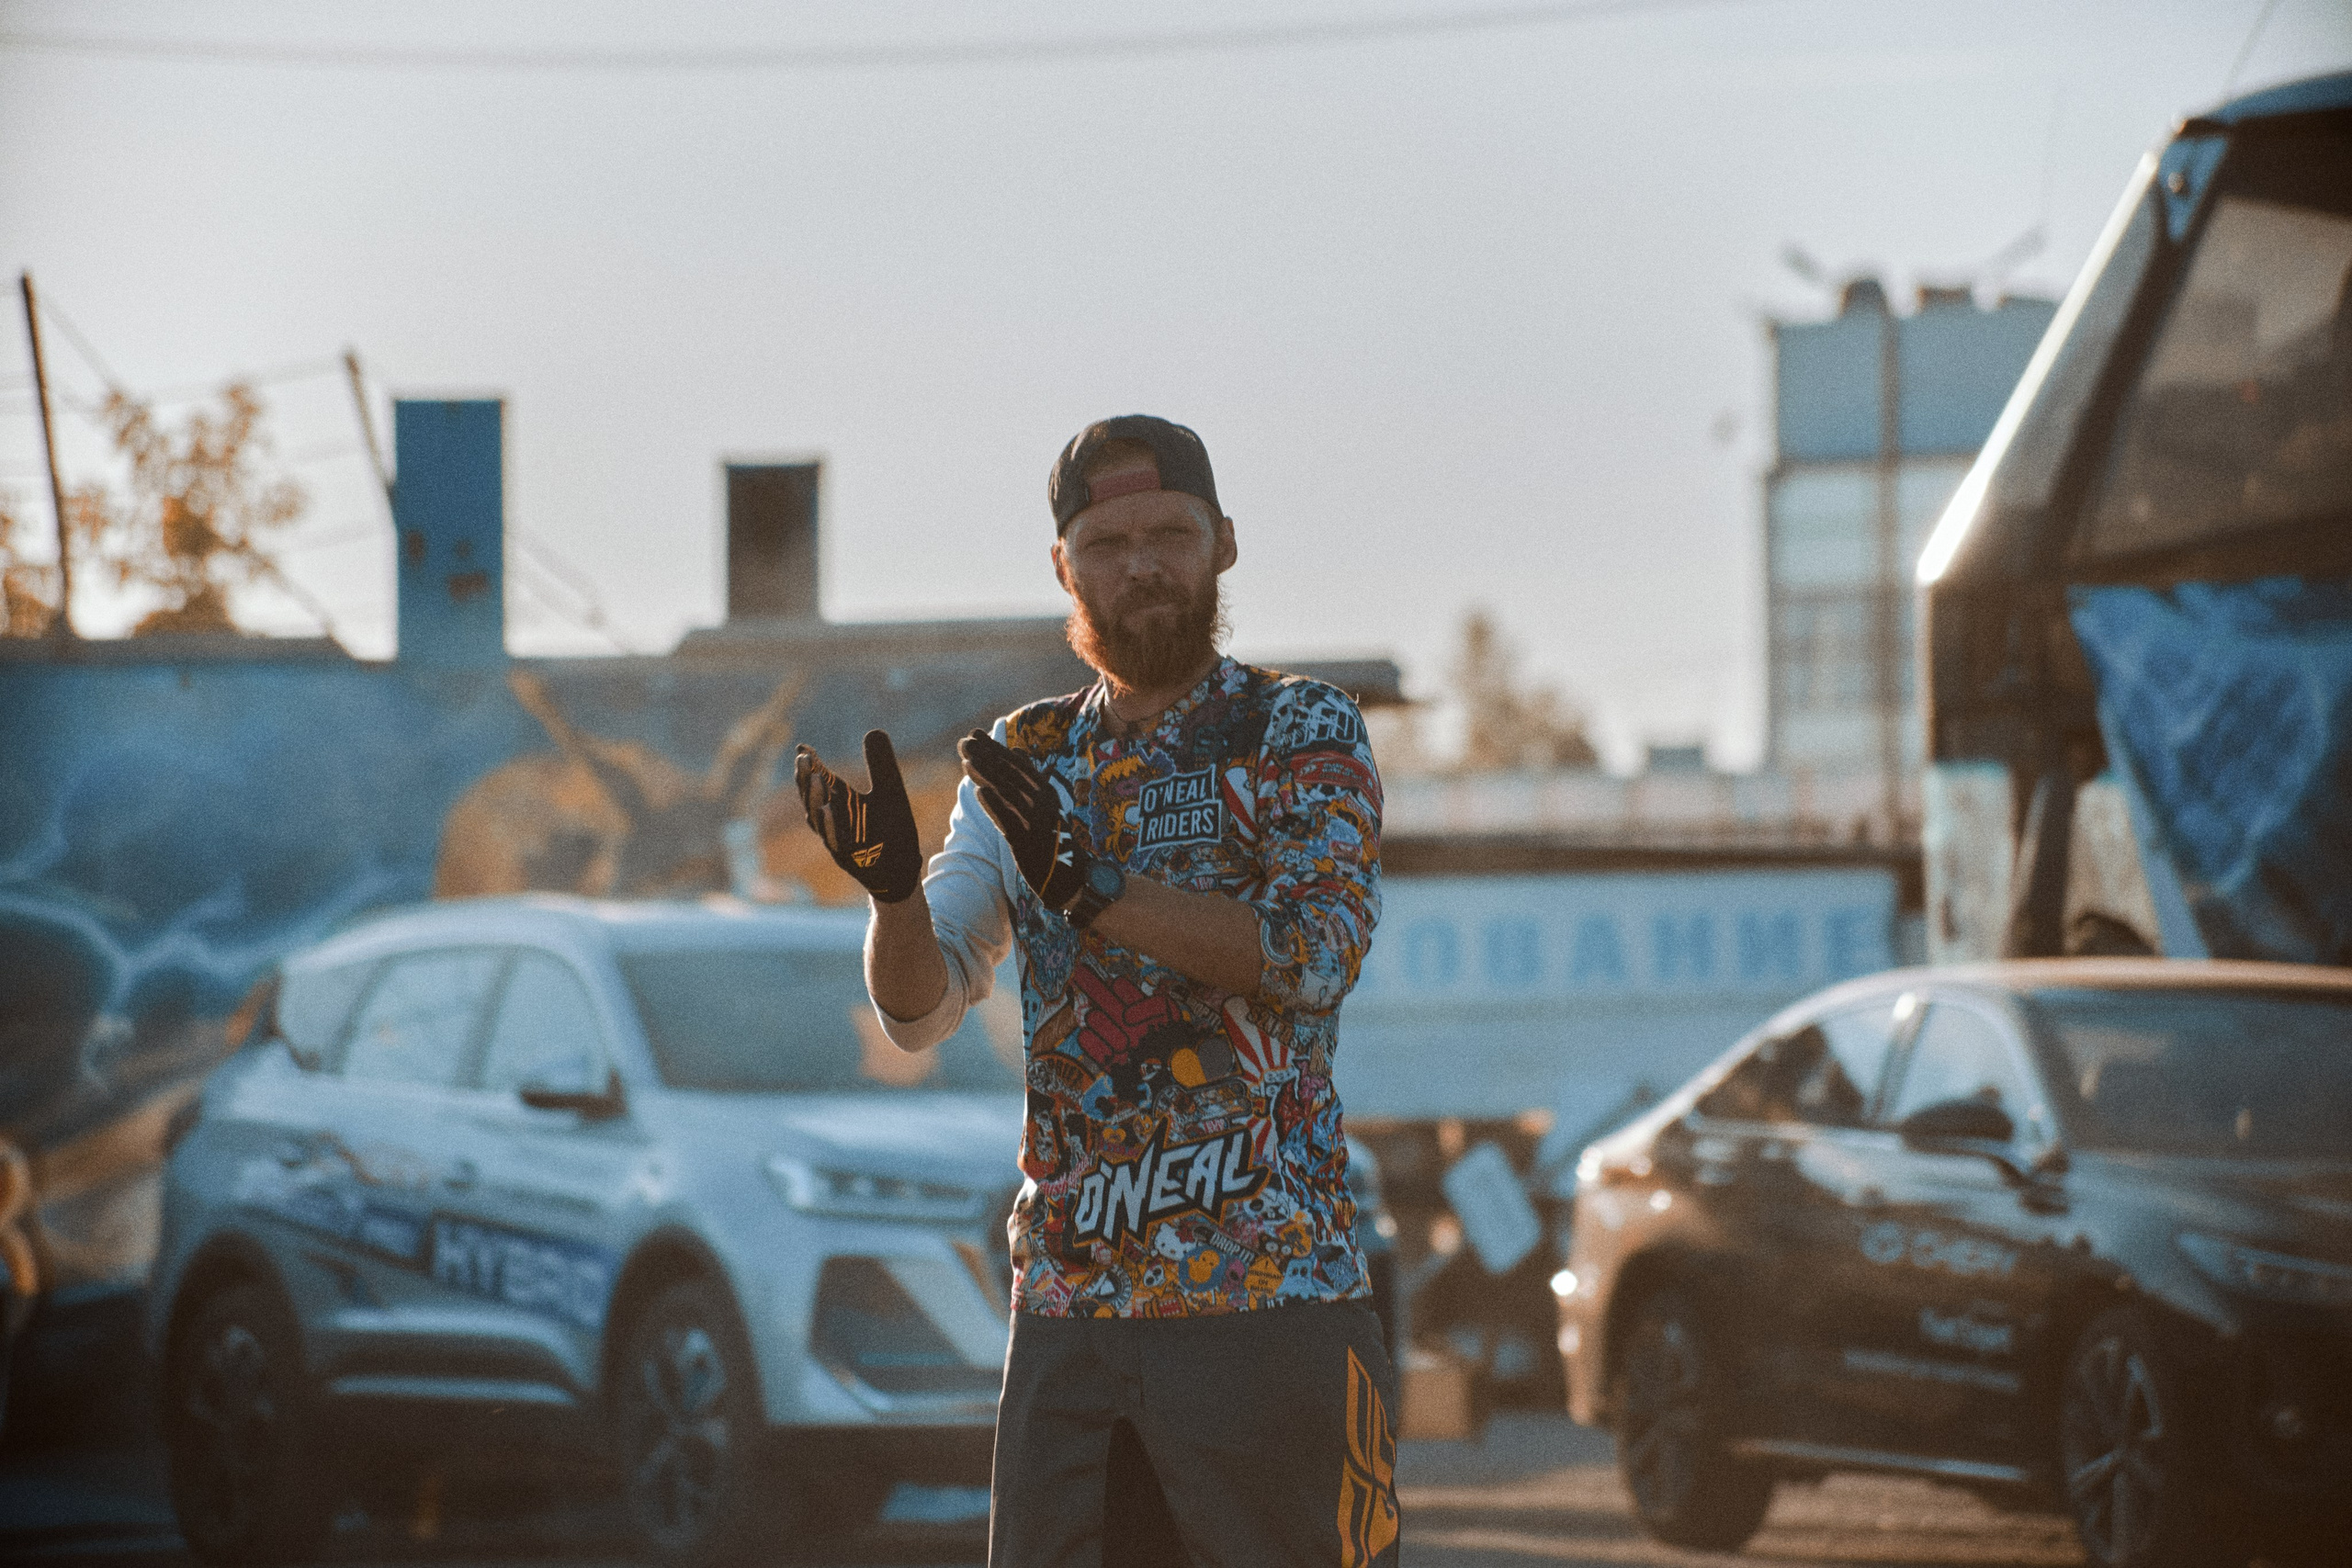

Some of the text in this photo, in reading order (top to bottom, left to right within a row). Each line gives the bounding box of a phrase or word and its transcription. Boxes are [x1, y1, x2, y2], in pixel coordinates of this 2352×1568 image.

[1143, 777, 1207, 813] O'NEAL
[1146, 807, 1216, 842] RIDERS
[1365, 904, 1886, 989] ОВАНИЕ
[1075, 1131, 1256, 1241] O'NEAL
